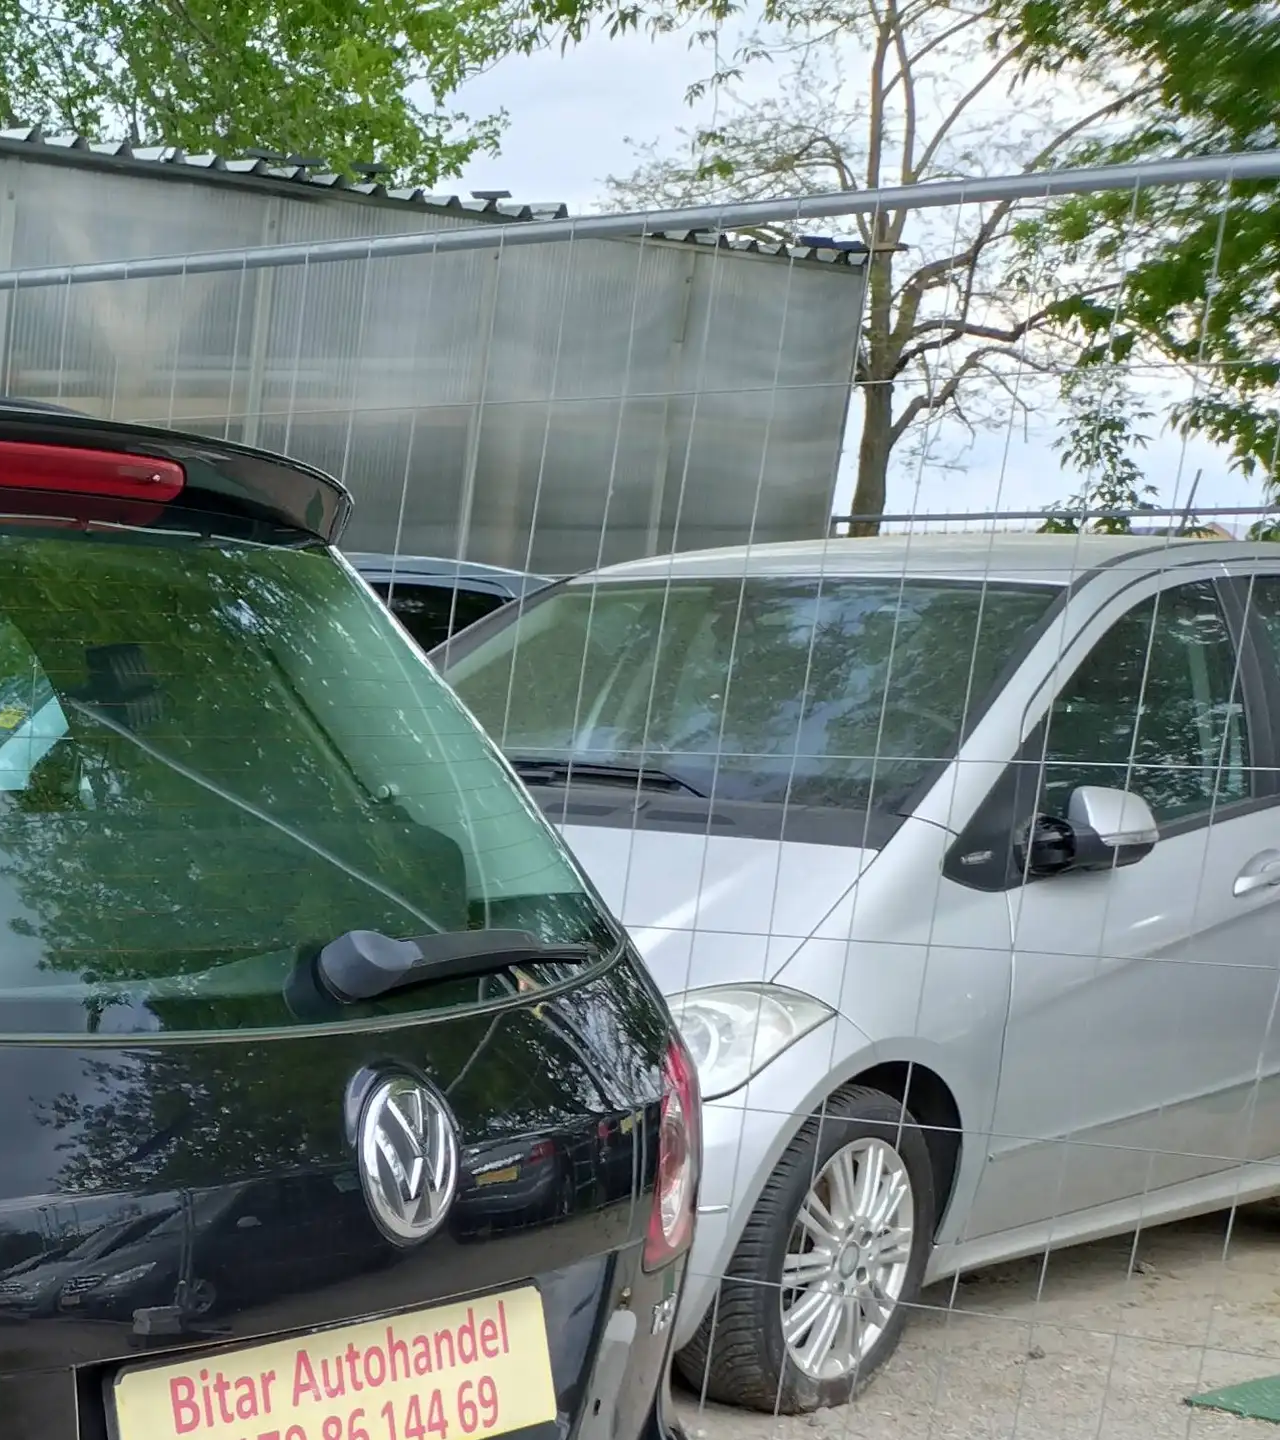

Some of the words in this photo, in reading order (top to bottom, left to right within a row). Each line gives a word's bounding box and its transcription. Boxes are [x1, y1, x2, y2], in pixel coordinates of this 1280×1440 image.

[169, 1369, 277, 1434] Bitar
[292, 1302, 511, 1407] Autohandel
[456, 1375, 499, 1433] 69
